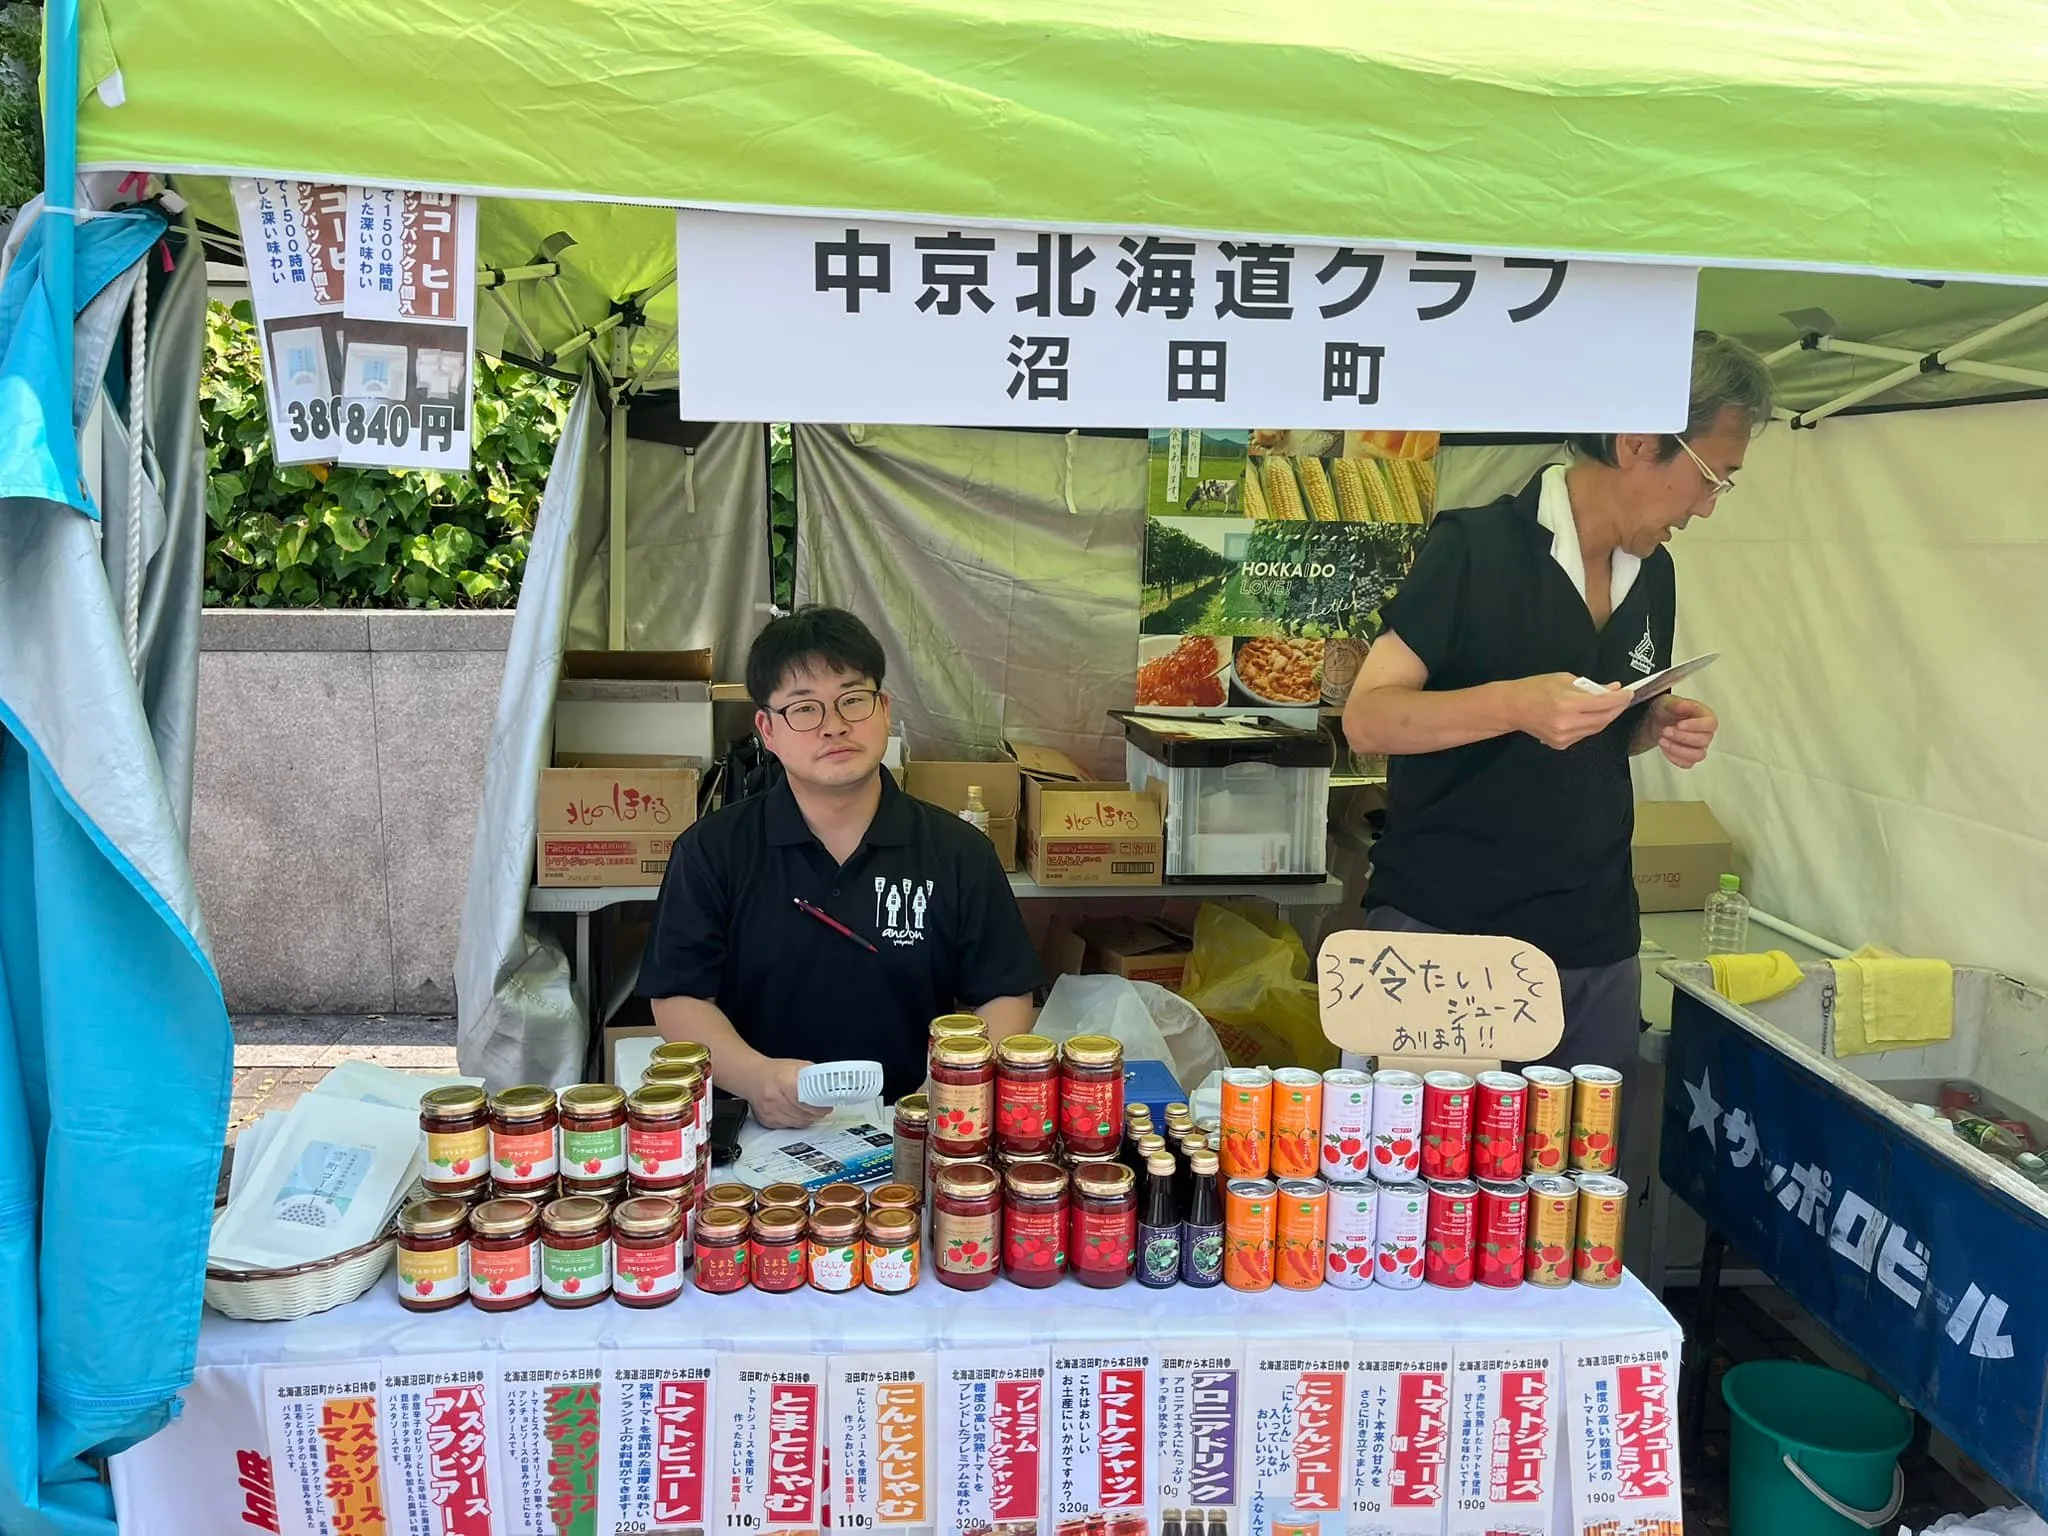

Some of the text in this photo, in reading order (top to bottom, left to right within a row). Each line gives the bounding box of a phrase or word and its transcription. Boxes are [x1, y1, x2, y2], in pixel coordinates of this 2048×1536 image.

[1240, 580, 1292, 596] LOVE!
[1242, 562, 1336, 577] HOKKAIDO
[1349, 945, 1493, 1004] 冷たい
[1448, 995, 1537, 1025] ジュース
[456, 1385, 492, 1517] パスタソース
[575, 1383, 601, 1512] パスタソース
[655, 1386, 696, 1520] トマトピューレ
[764, 1392, 813, 1513] とまとじゃむ
[876, 1388, 921, 1517] にんじんじゃむ
[989, 1402, 1013, 1511] トマトケチャップ
[1015, 1384, 1040, 1452] プレミアム
[1079, 1375, 1090, 1454] これはおいしい
[1098, 1376, 1136, 1507] トマトケチャップ
[1188, 1372, 1231, 1501] アロニアドリンク
[1267, 1409, 1280, 1477] 入っていない
[1291, 1381, 1332, 1507] にんじんジュース
[1409, 1379, 1448, 1500] トマトジュース
[1512, 1377, 1549, 1495] トマトジュース
[1616, 1410, 1643, 1498] プレミアム
[1636, 1367, 1673, 1487] トマトジュース
[318, 1406, 363, 1536] トマト&ガーリ
[348, 1398, 386, 1523] パスタソース
[425, 1397, 468, 1536] アラビアー
[1587, 1493, 1615, 1503] 190g
[615, 1521, 646, 1533] 220g
[726, 1514, 761, 1529] 110g
[839, 1515, 872, 1529] 110g
[956, 1518, 985, 1529] 320g
[1059, 1502, 1088, 1513] 320g
[1353, 1502, 1380, 1512] 190g
[1458, 1500, 1485, 1510] 190g
